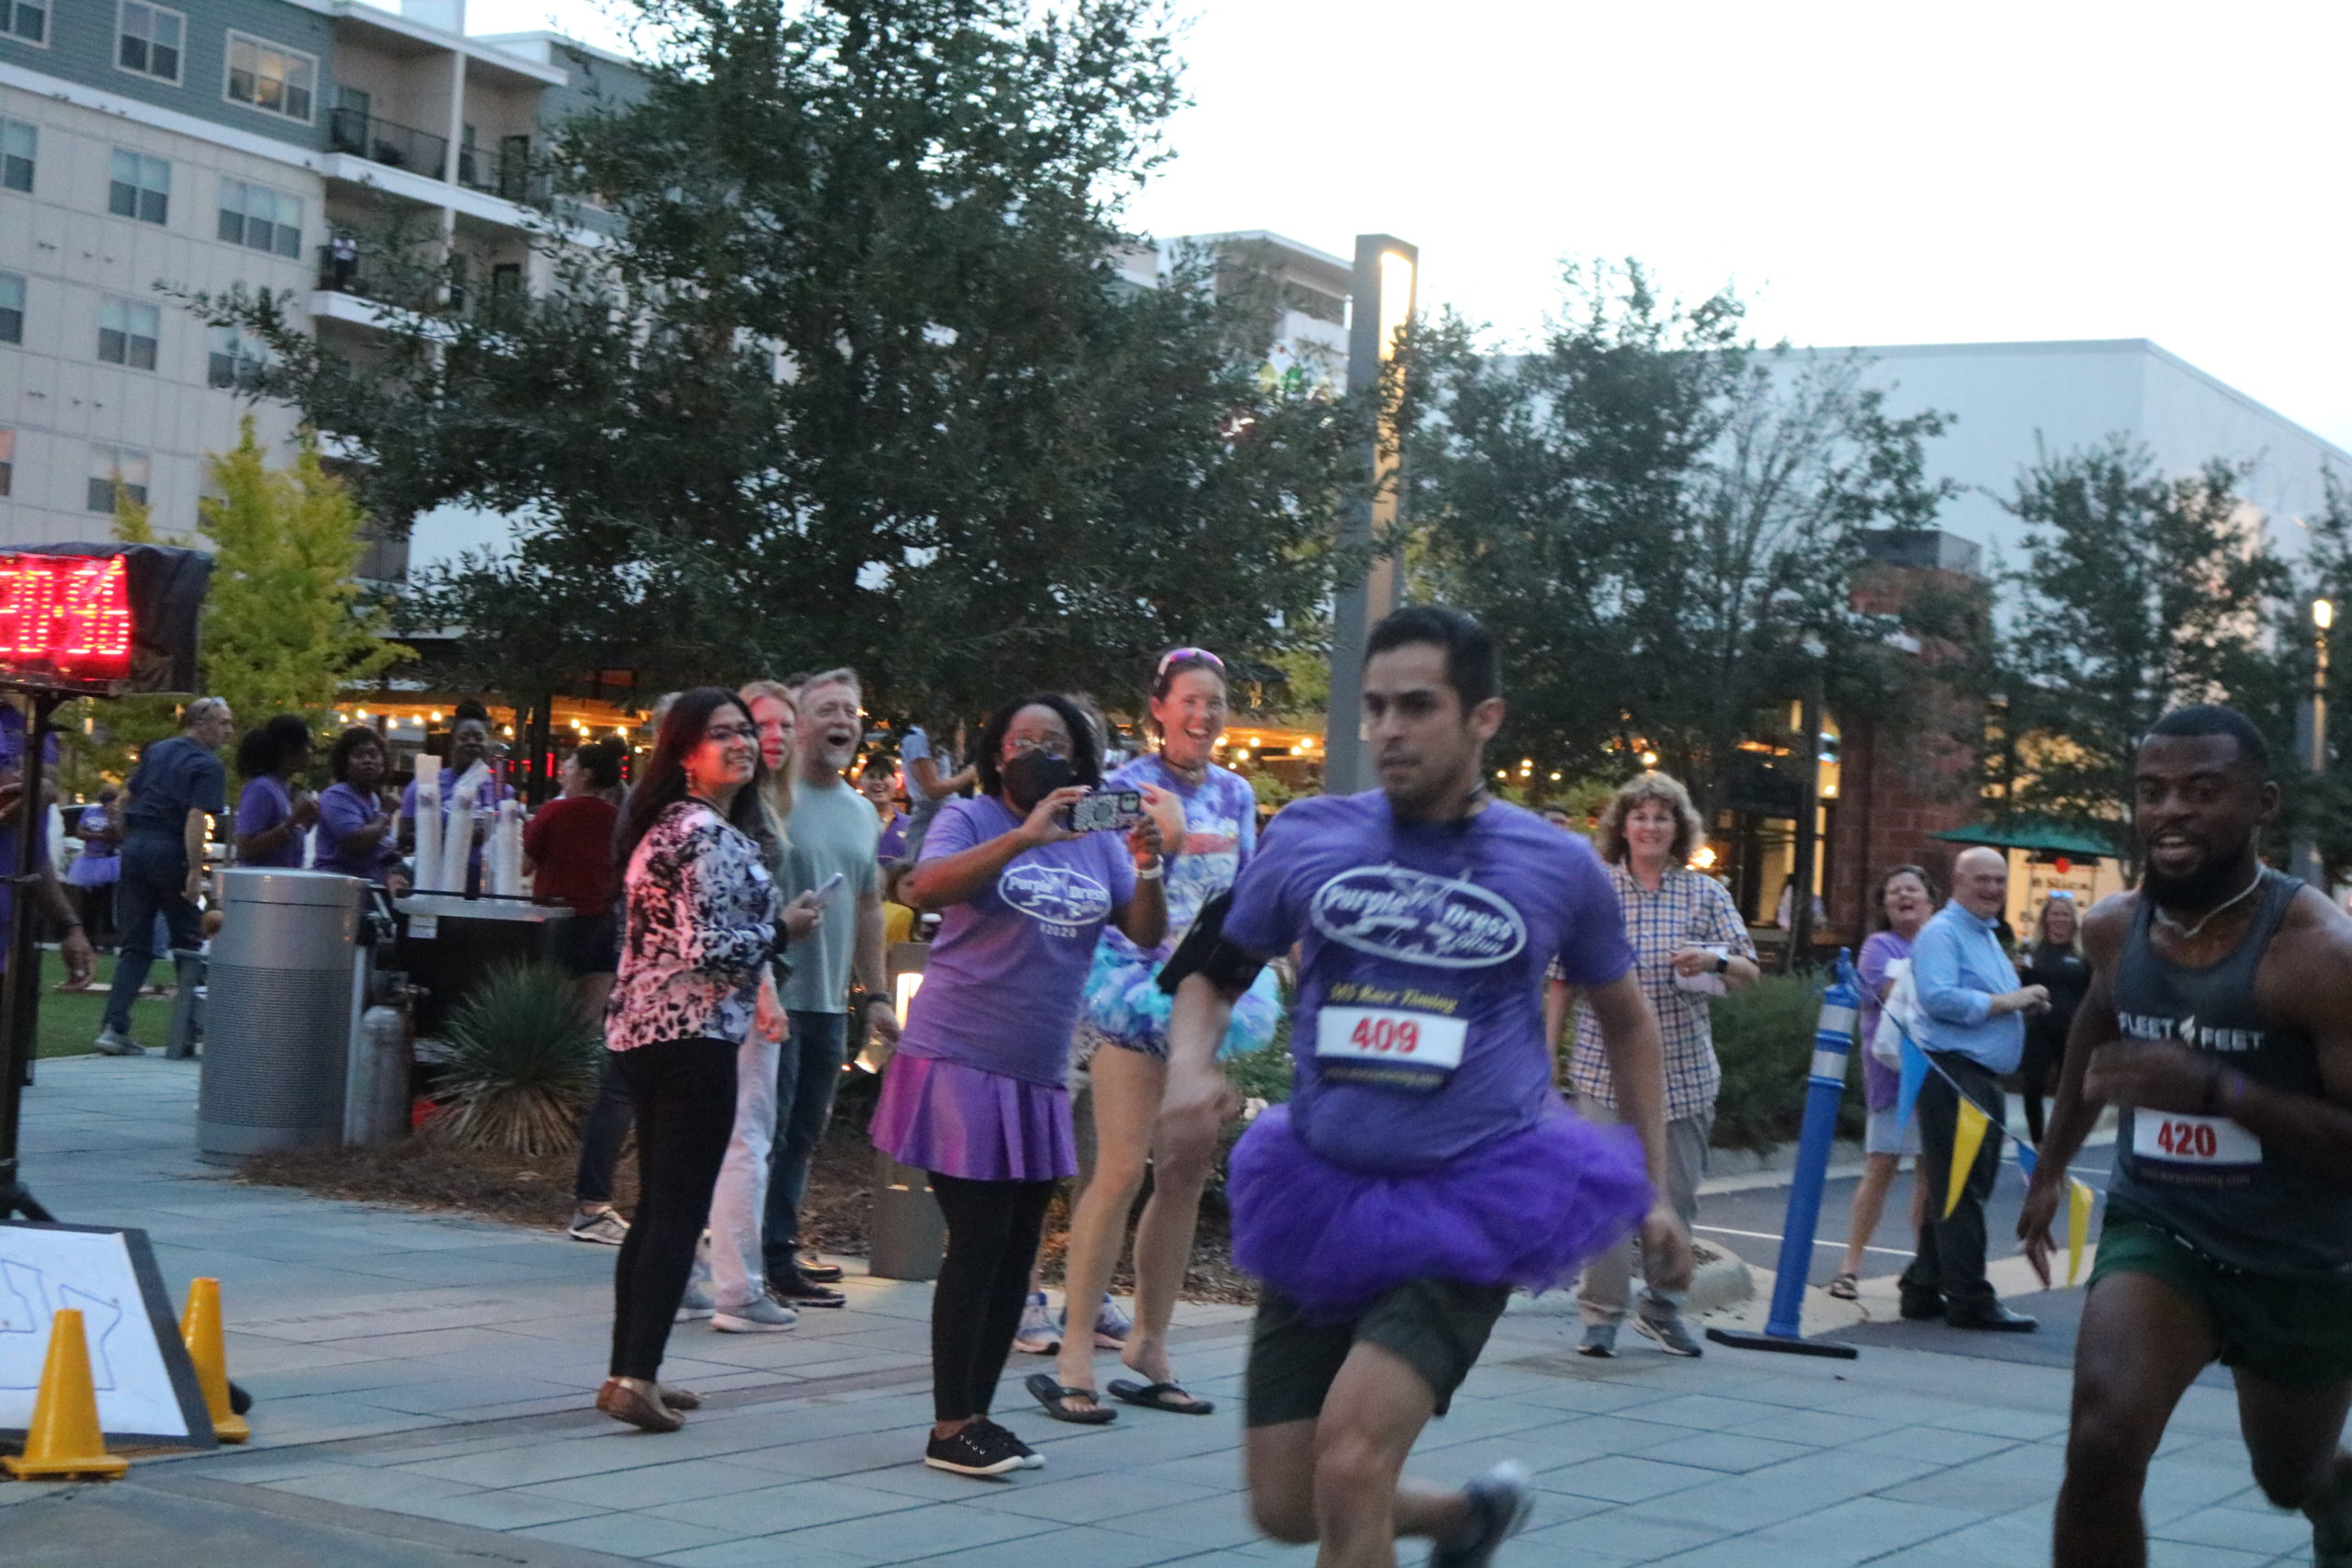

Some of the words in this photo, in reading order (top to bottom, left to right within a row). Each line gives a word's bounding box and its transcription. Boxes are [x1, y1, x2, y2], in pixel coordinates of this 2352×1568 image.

[1324, 886, 1408, 915] Purple
[1443, 903, 1514, 941] Dress
[1351, 1017, 1420, 1055] 409
[2118, 1011, 2175, 1041] FLEET
[2201, 1026, 2265, 1052] FEET
[2157, 1119, 2217, 1158] 420
